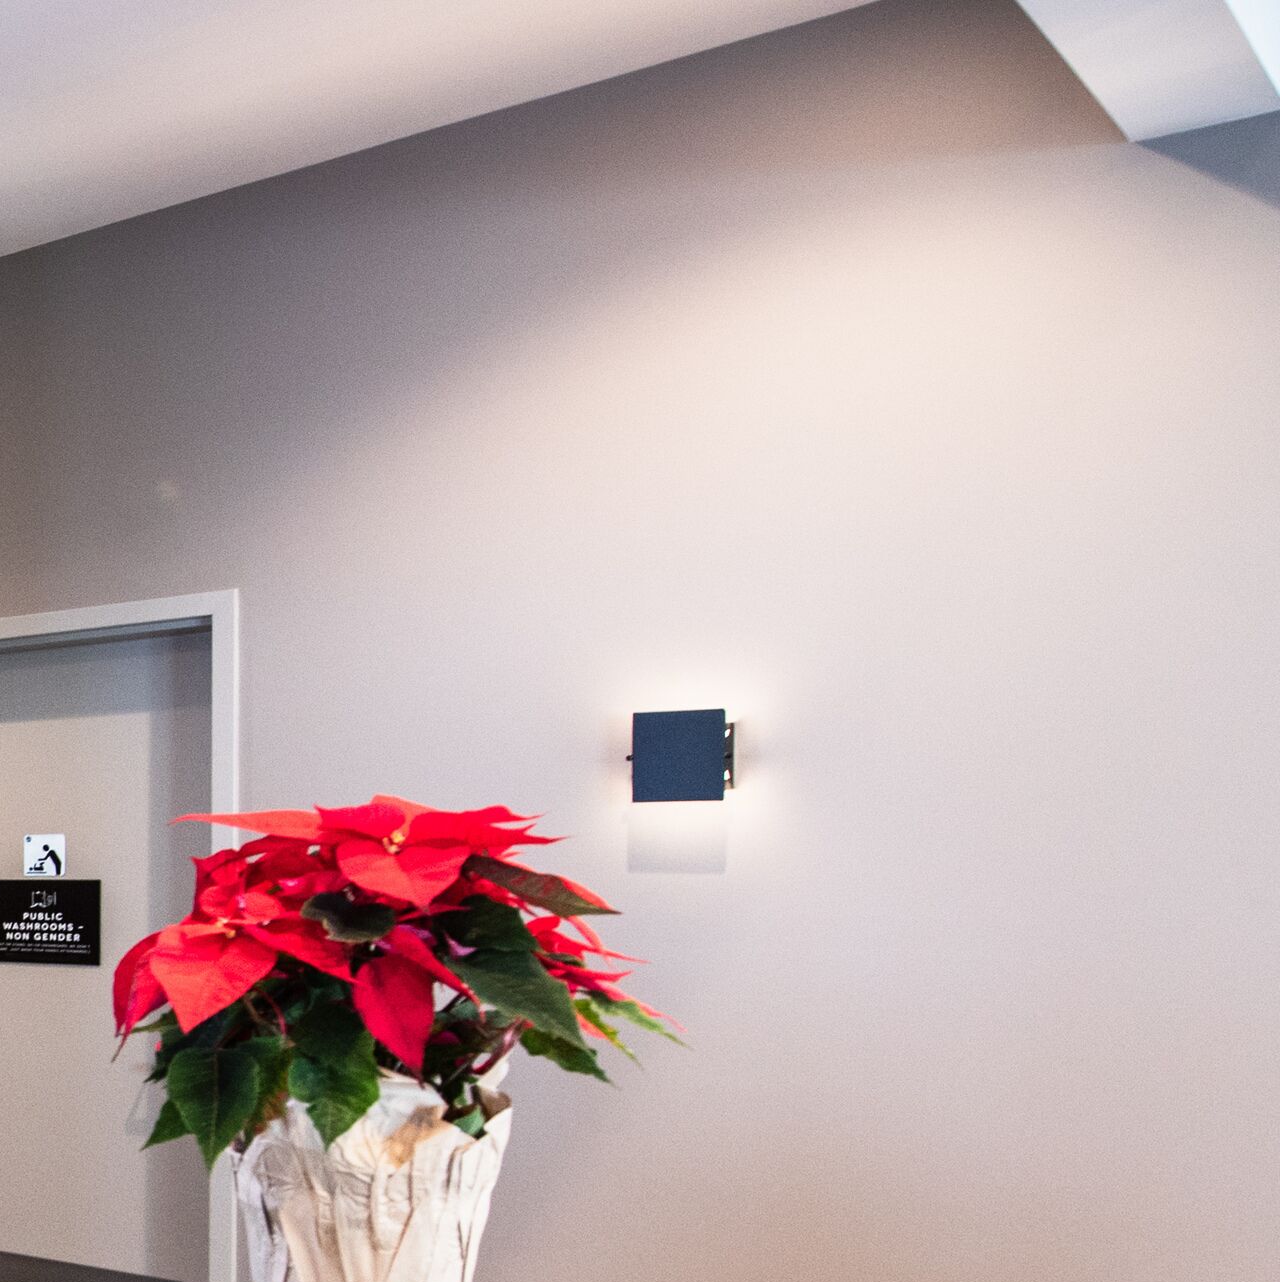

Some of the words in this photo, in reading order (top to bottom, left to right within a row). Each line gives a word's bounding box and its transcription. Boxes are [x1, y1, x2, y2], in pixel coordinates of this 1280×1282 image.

[22, 912, 63, 921] PUBLIC
[2, 922, 74, 932] WASHROOMS
[6, 932, 30, 941] NON
[33, 932, 81, 942] GENDER
